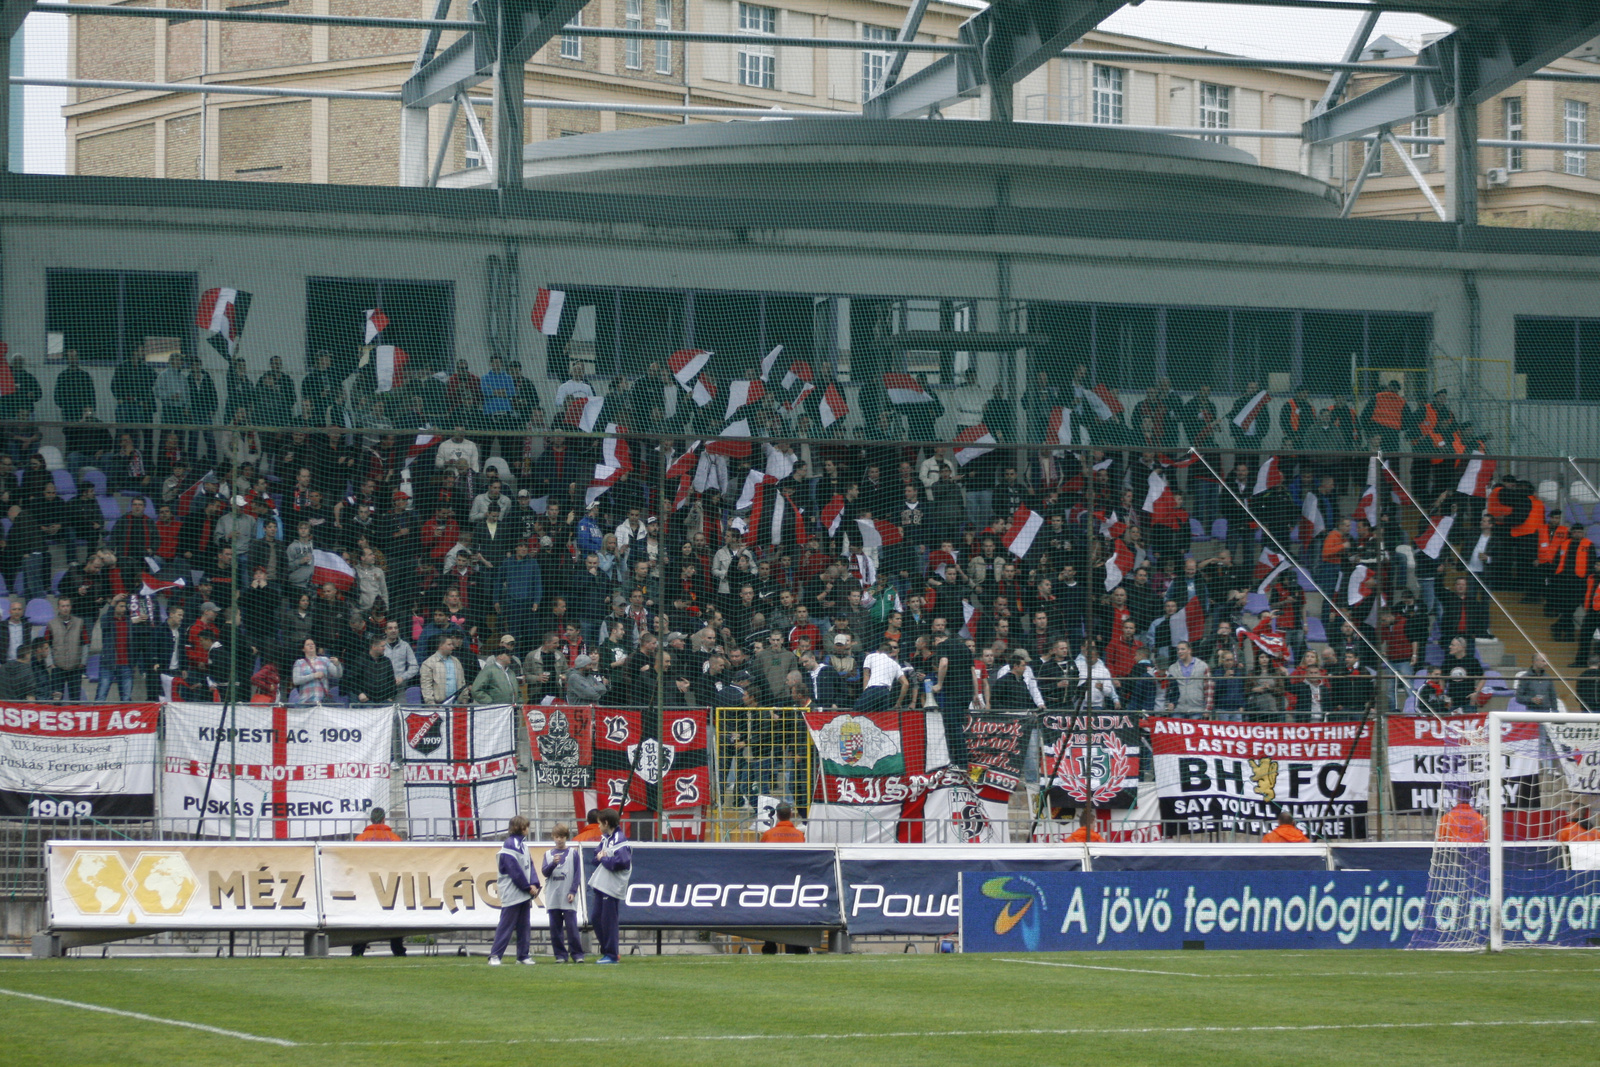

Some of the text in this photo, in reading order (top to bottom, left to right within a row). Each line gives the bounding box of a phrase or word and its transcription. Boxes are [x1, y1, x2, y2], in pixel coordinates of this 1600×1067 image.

[107, 710, 147, 730] AC.
[1042, 715, 1134, 730] GUARDIA
[1154, 720, 1369, 740] AND THOUGH NOTHING
[199, 727, 362, 743] KISPESTI AC. 1909
[422, 737, 441, 745] 1909
[1185, 738, 1341, 757] LASTS FOREVER
[48, 760, 93, 772] Ferenc
[166, 757, 191, 774] WE
[261, 766, 297, 780] NOT
[303, 764, 327, 779] BE
[334, 762, 389, 778] MOVED
[988, 773, 1018, 790] 1909
[28, 799, 92, 818] 1909
[184, 796, 254, 817] PUSKÁS
[261, 800, 333, 816] FERENC
[1174, 797, 1355, 819] SAY YOU'LL ALWAYS
[1188, 815, 1345, 836] BE MY PLESURE
[209, 865, 306, 911] MÉZ
[1060, 886, 1088, 933] A
[1097, 886, 1172, 943] jövő
[1185, 880, 1425, 943] technológiája
[1435, 897, 1457, 931] a
